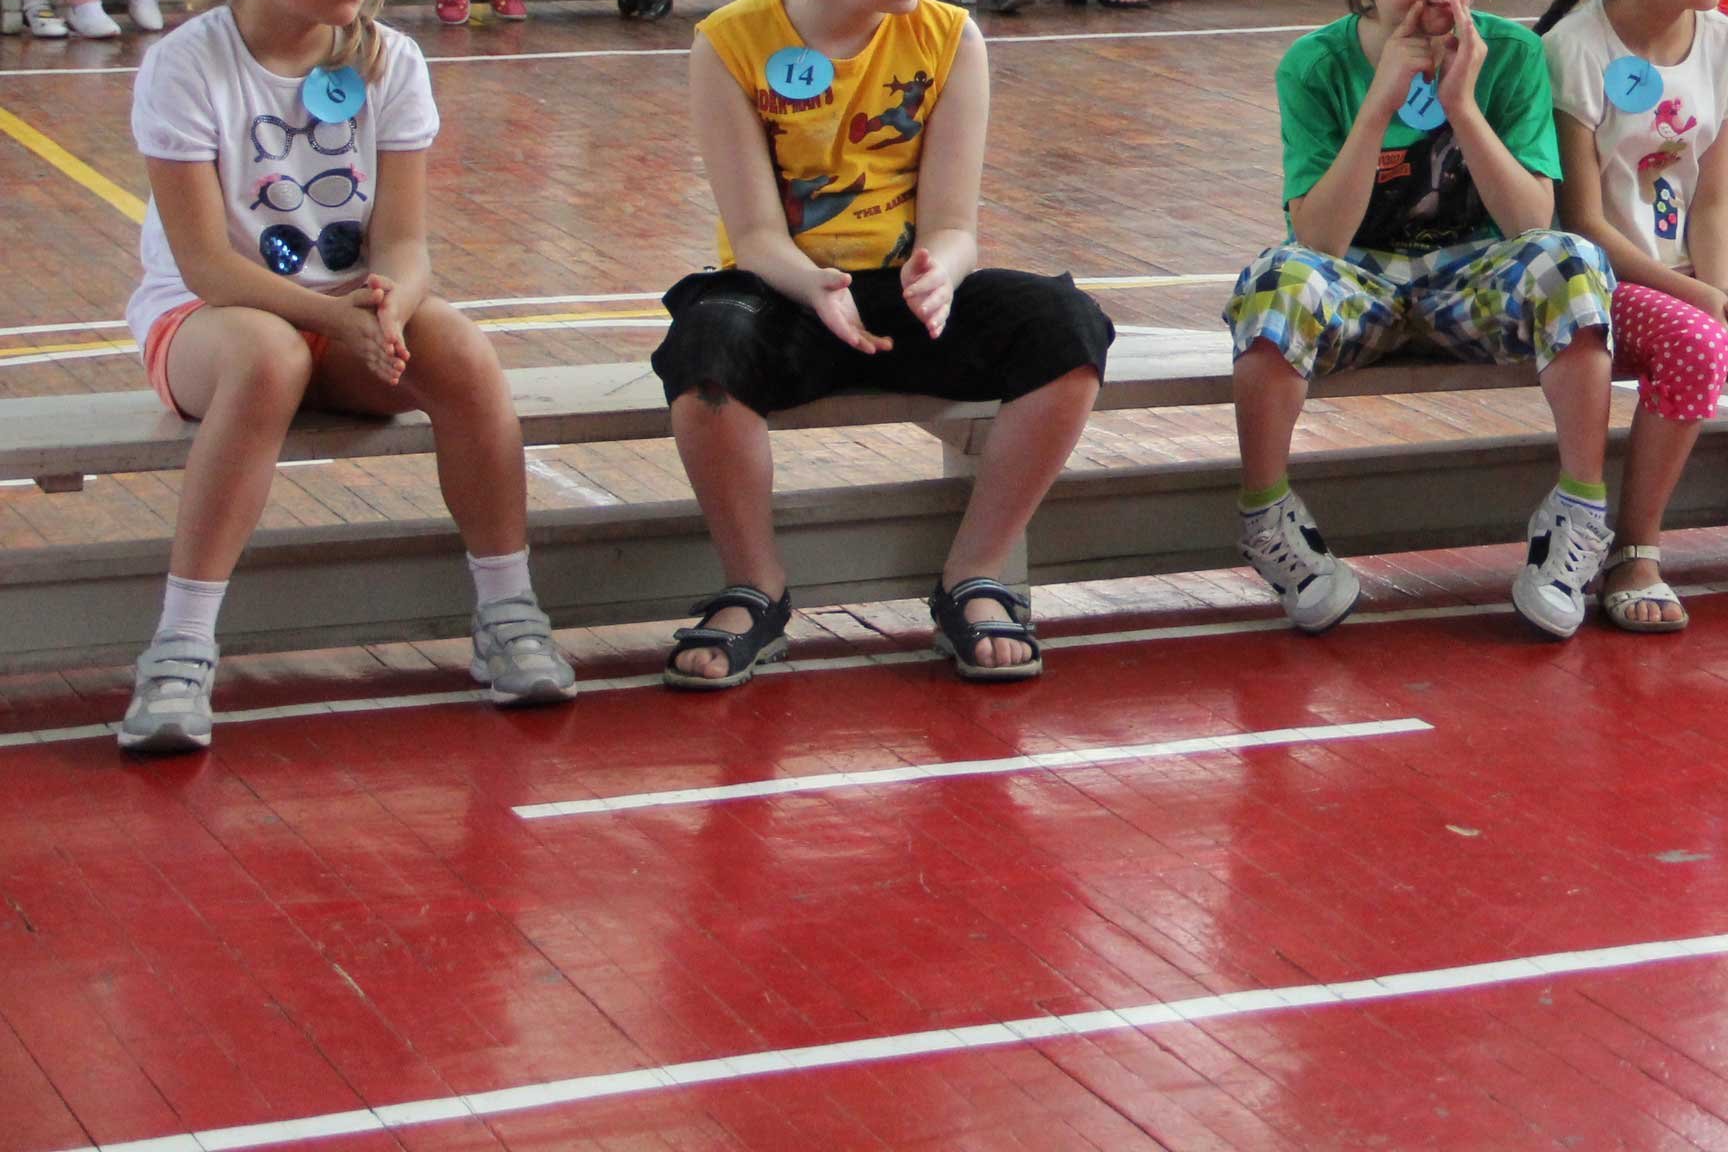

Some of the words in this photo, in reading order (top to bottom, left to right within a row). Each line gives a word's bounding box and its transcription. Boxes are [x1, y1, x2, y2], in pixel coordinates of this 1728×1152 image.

[784, 63, 815, 86] 14
[1626, 73, 1641, 96] 7
[326, 79, 347, 104] 6
[1407, 86, 1435, 117] 11
